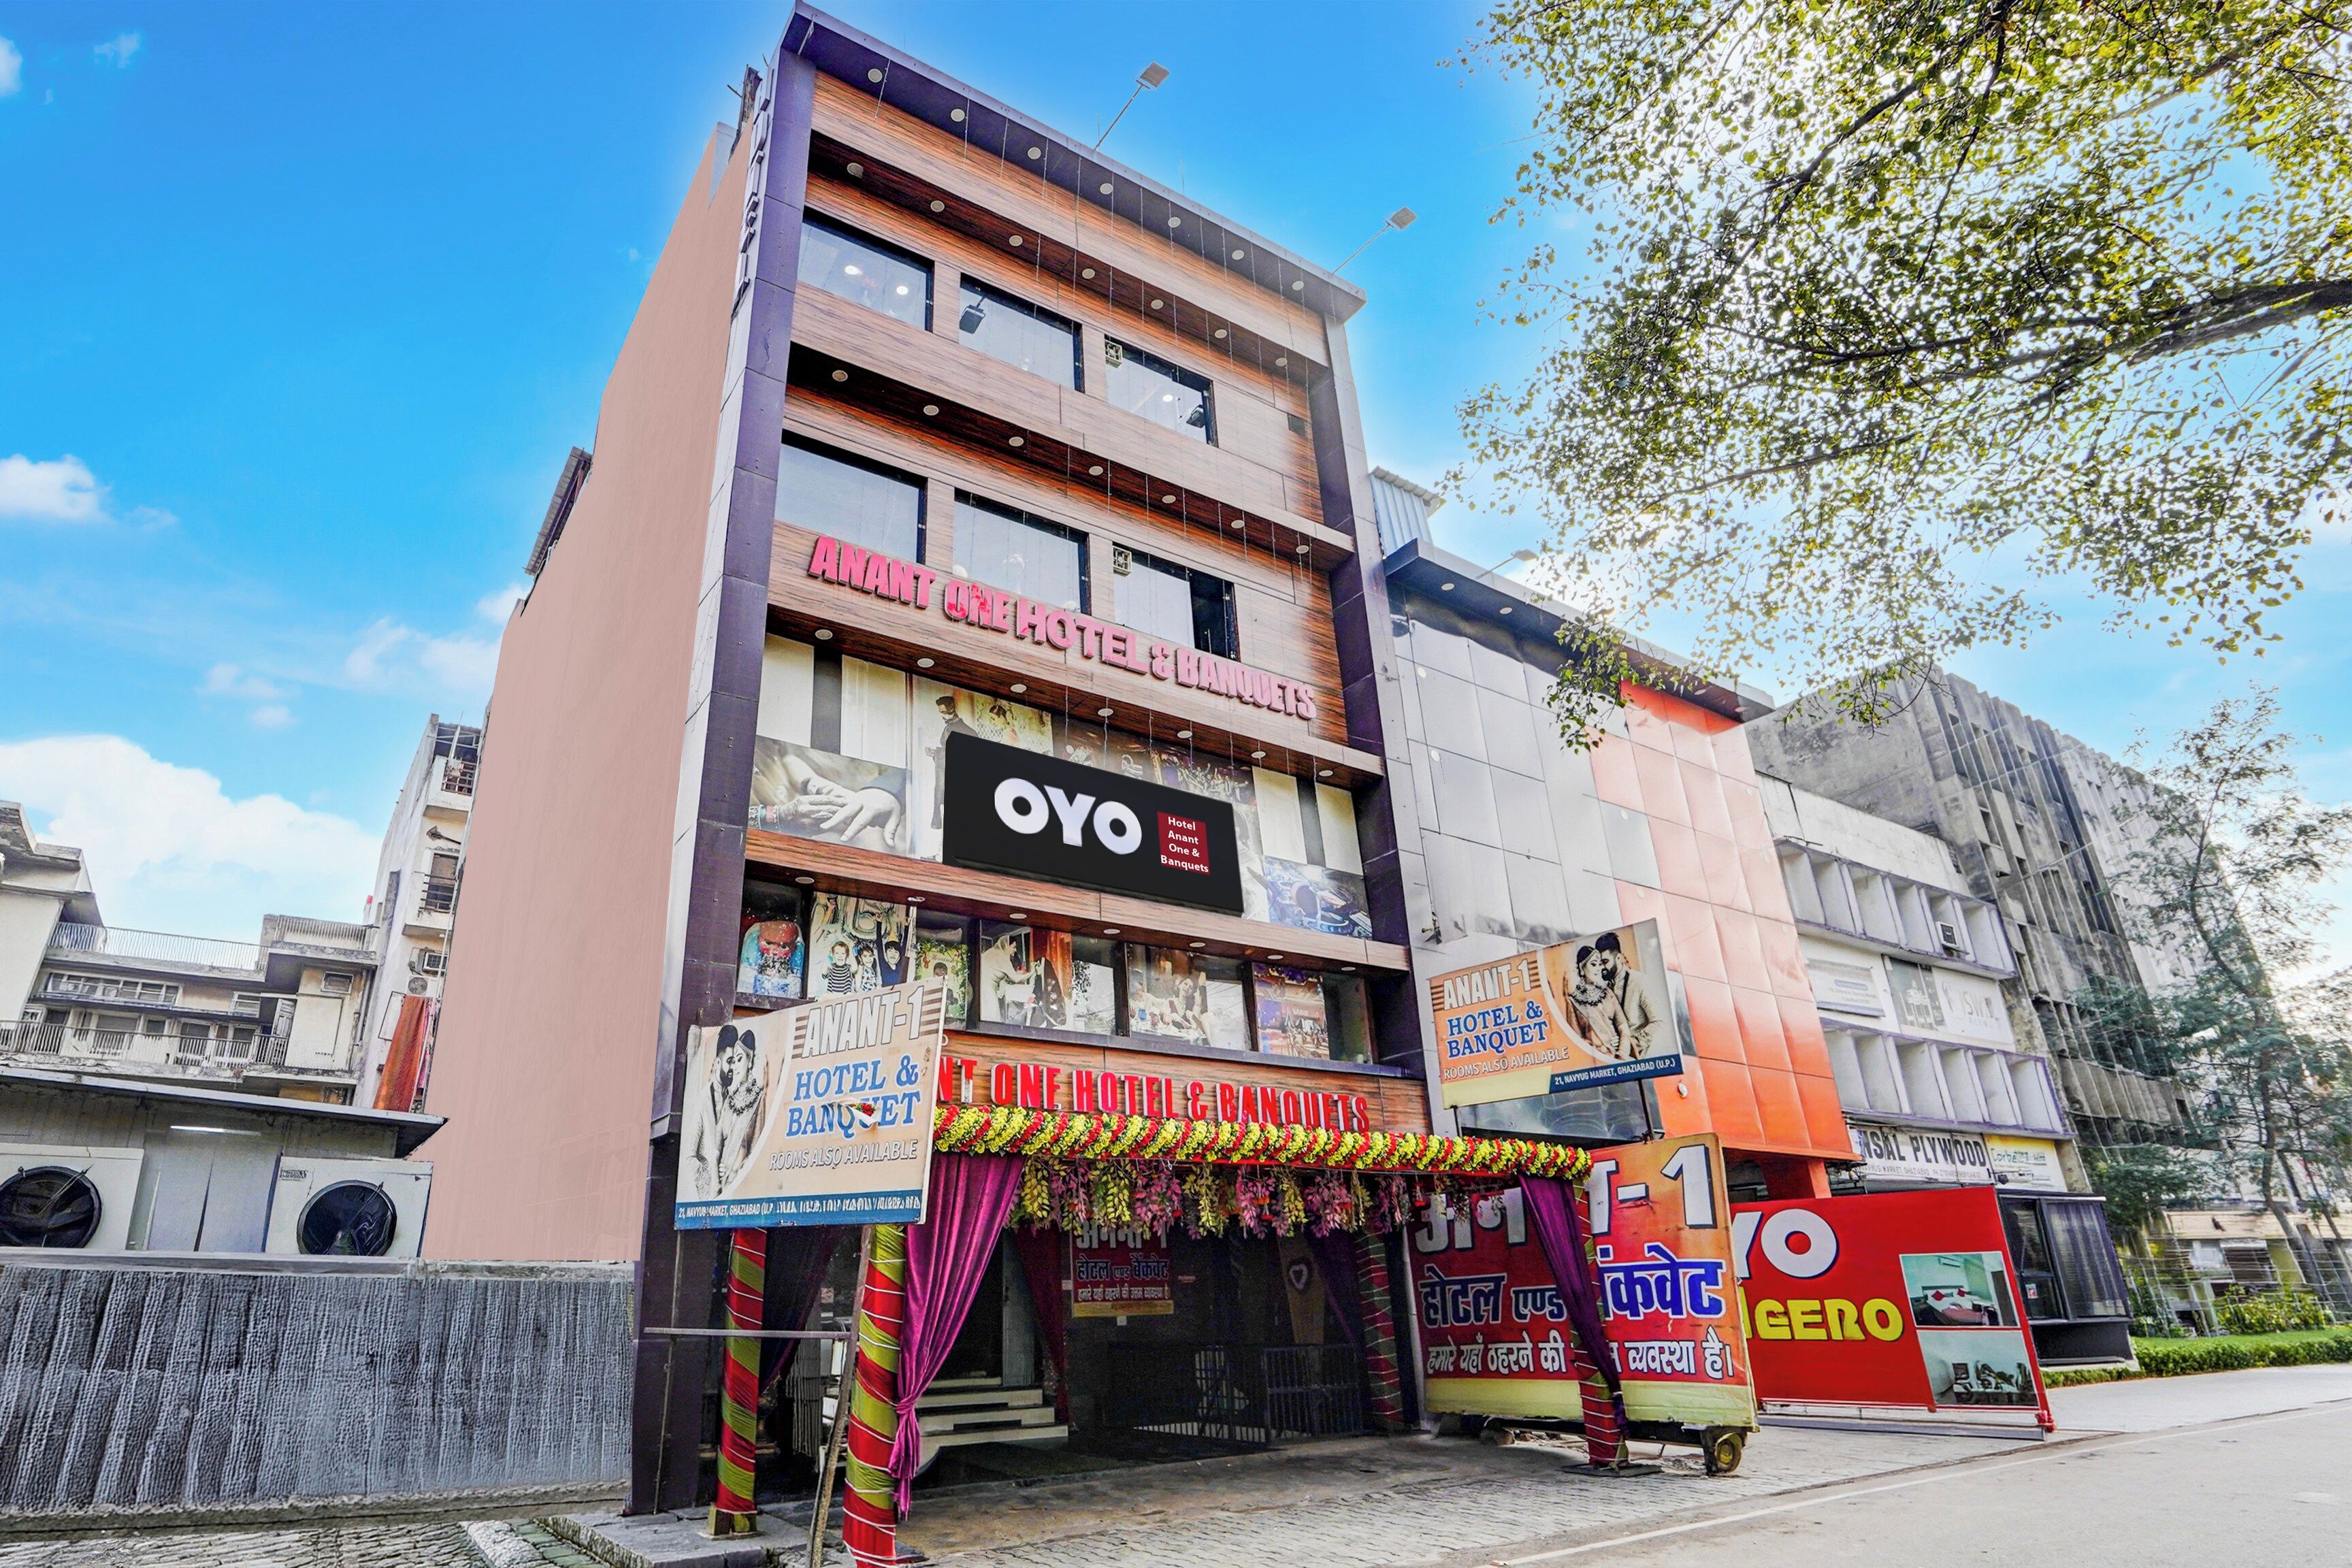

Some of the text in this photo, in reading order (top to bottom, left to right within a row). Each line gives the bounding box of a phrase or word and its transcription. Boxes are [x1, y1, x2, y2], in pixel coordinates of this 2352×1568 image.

[808, 535, 1317, 720] ANANT ONE HOTEL & BANQUETS
[994, 777, 1142, 855] OYO
[1168, 817, 1195, 830] Hotel
[1168, 830, 1198, 844] Anant
[1169, 843, 1199, 857] One &
[1160, 855, 1209, 872] Banquets
[1443, 958, 1531, 1011] ANANT-1
[801, 985, 924, 1059] ANANT-1
[1447, 1000, 1543, 1036] HOTEL &
[1447, 1021, 1548, 1058] BANQUET
[793, 1055, 919, 1102] HOTEL &
[1444, 1047, 1569, 1080] ROOMS ALSO AVAILABLE
[1554, 1058, 1676, 1085] 21, NAVYUG MARKET, GHAZIABAD (U.P.)
[991, 1062, 1062, 1109] ONE
[1072, 1069, 1179, 1119] HOTEL
[1186, 1081, 1208, 1120] &
[1215, 1082, 1369, 1133] BANQUETS
[769, 1139, 919, 1171] ROOMS ALSO AVAILABLE
[1909, 1134, 1987, 1167] PLYWOOD
[730, 1203, 761, 1215] GHAZIABAD
[1076, 1253, 1111, 1281] होटल
[1418, 1264, 1507, 1328] होटल
[1426, 1335, 1458, 1375] हमारे
[1488, 1330, 1534, 1375] ठहरने
[1538, 1329, 1567, 1373] की
[1624, 1341, 1696, 1374] व्यवस्था
